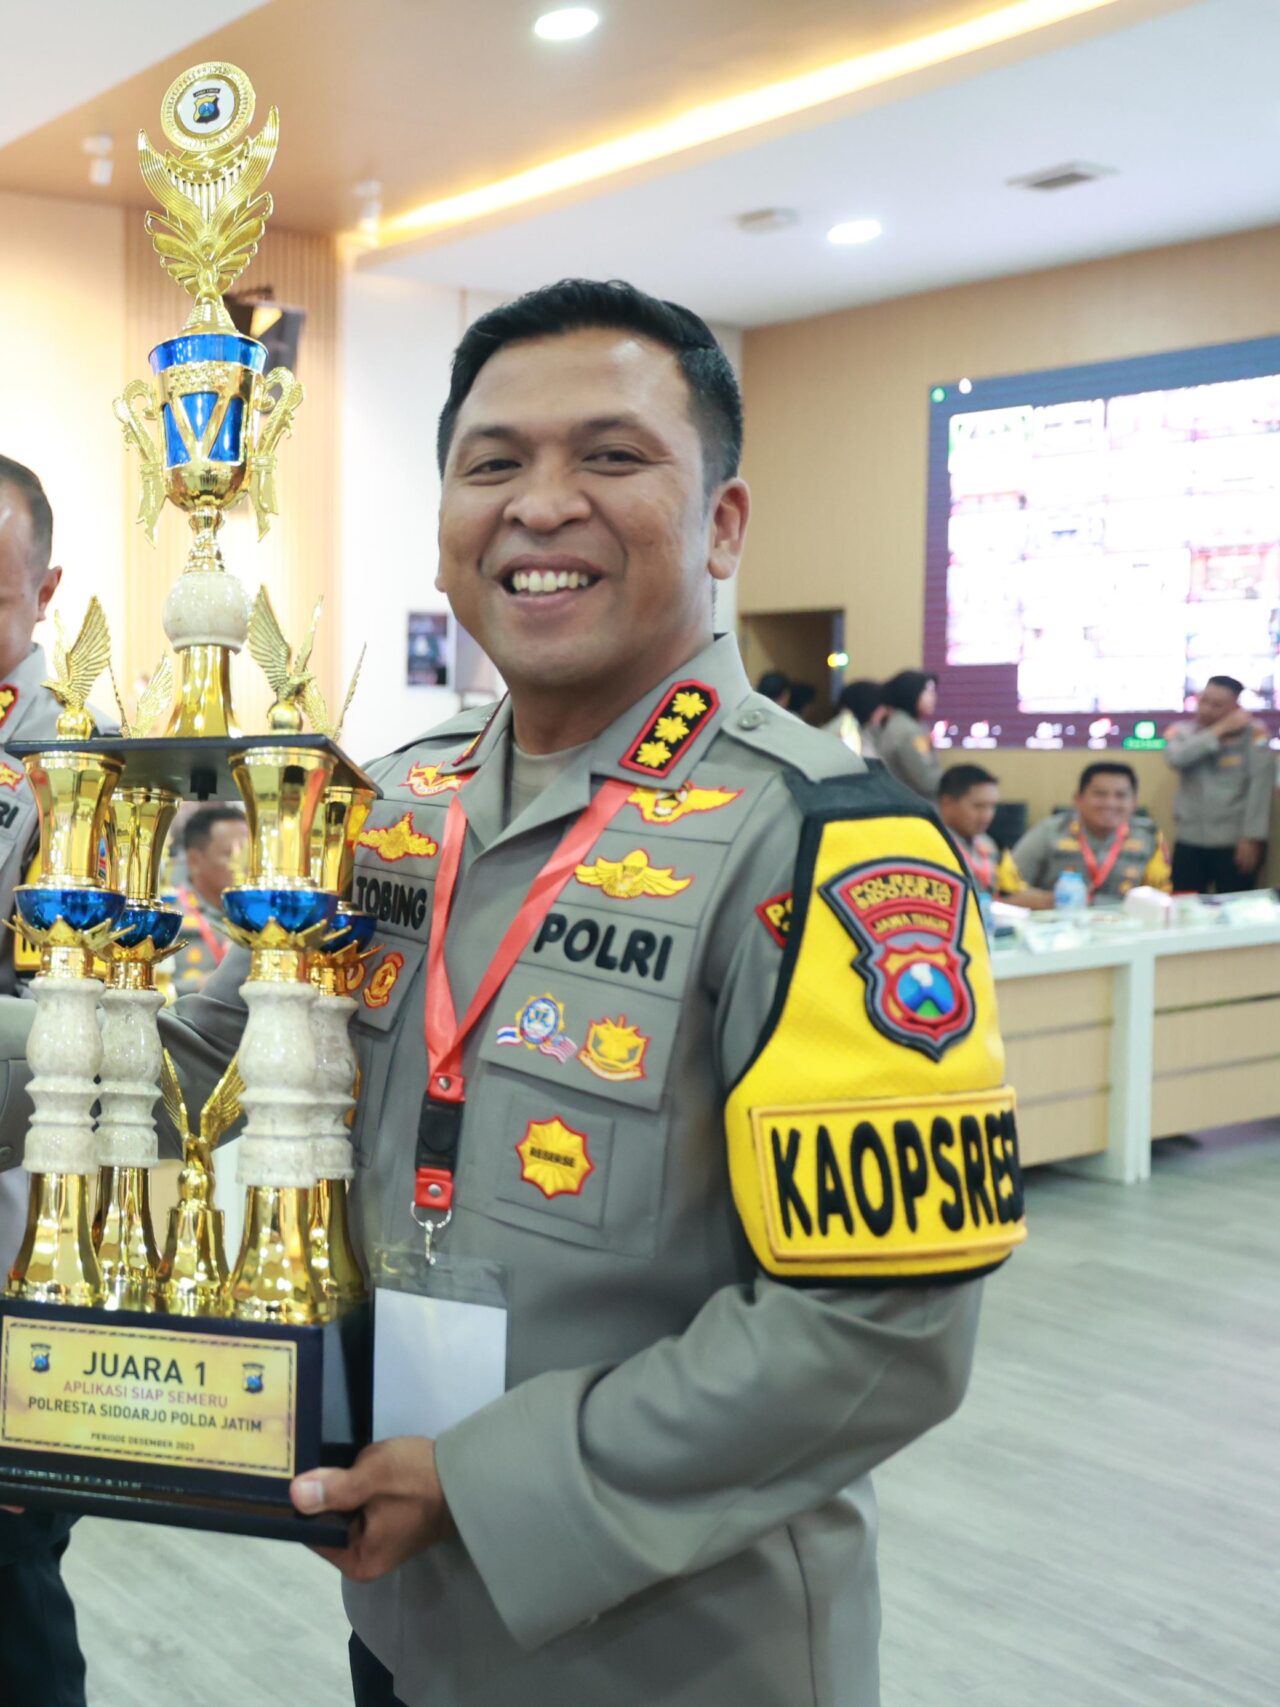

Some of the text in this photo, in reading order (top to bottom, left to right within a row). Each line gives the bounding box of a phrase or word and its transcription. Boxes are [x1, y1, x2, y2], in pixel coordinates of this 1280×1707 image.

[356, 875, 428, 930] TOBING
[533, 913, 674, 981] POLRI
[82, 1351, 206, 1387] JUARA 1
[63, 1379, 228, 1409] APLIKASI SIAP SEMERU
[28, 1396, 262, 1432] POLRESTA SIDOARJO POLDA JATIM
[91, 1432, 125, 1444] PERIODE
[128, 1436, 173, 1449] DESEMBER
